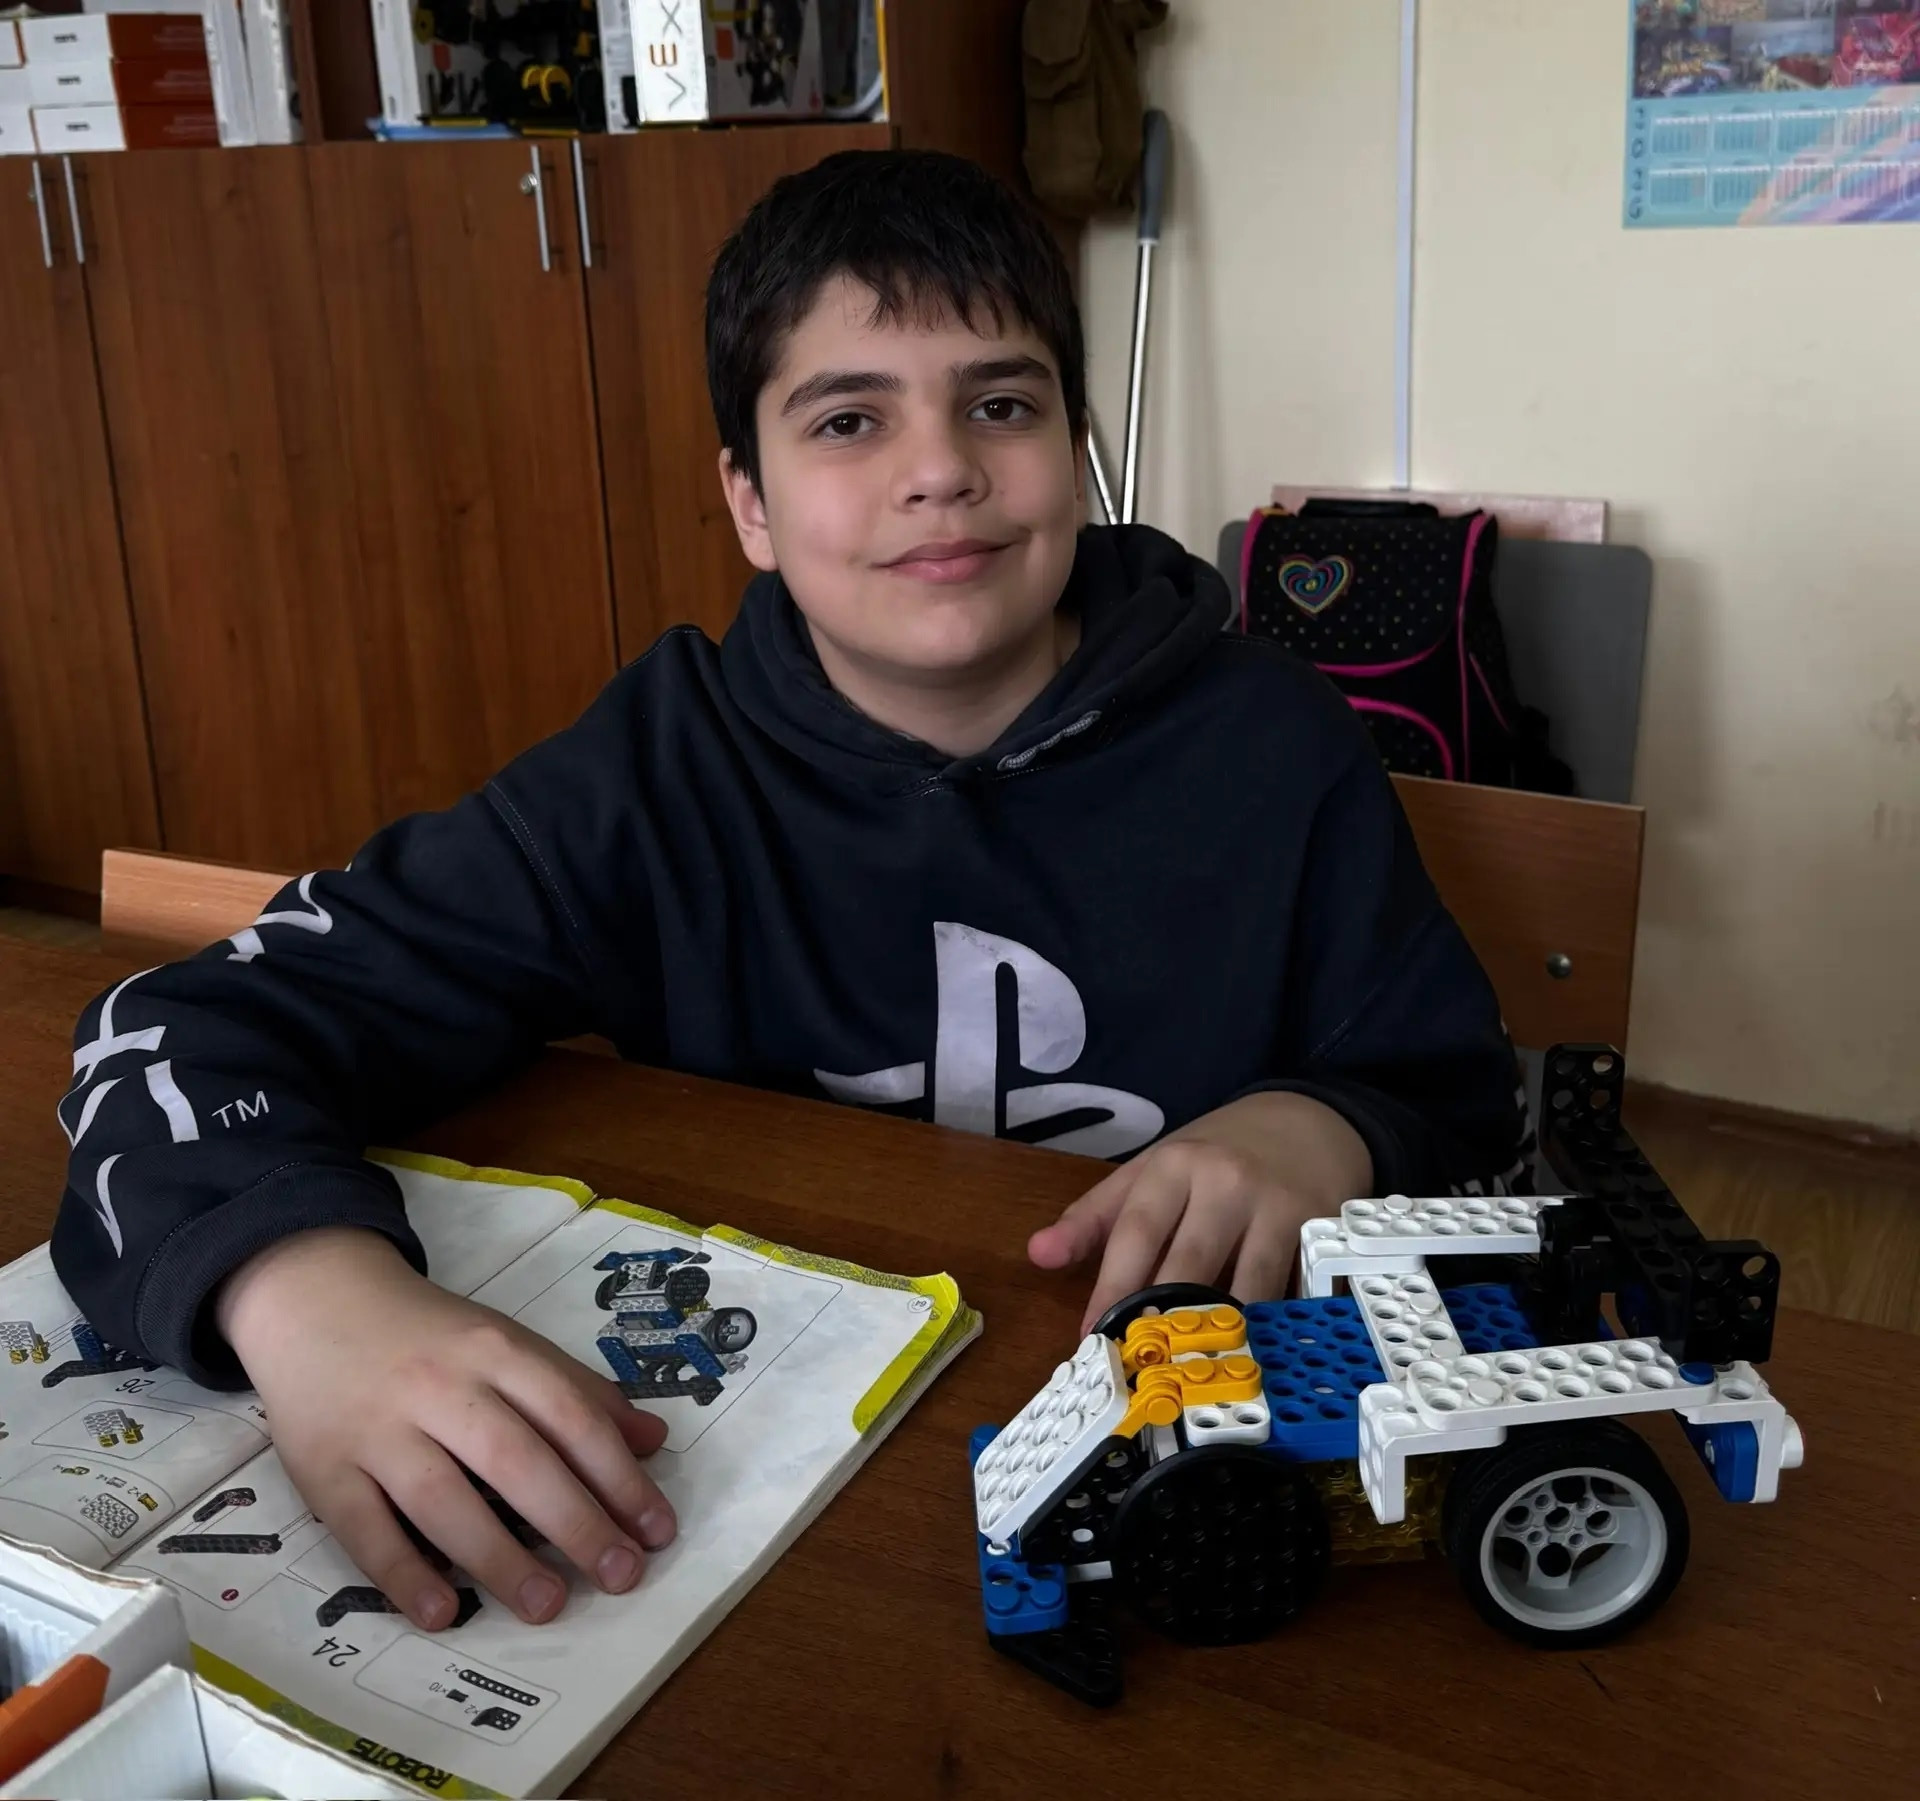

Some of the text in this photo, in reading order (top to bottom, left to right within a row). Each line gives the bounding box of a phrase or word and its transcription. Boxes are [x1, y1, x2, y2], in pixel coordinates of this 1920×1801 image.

[649, 1, 687, 112] VEX
[211, 1090, 270, 1129] TM
[115, 1377, 156, 1394] 26
[312, 1636, 361, 1668] 24
[346, 1737, 454, 1790] ROBOTIS
